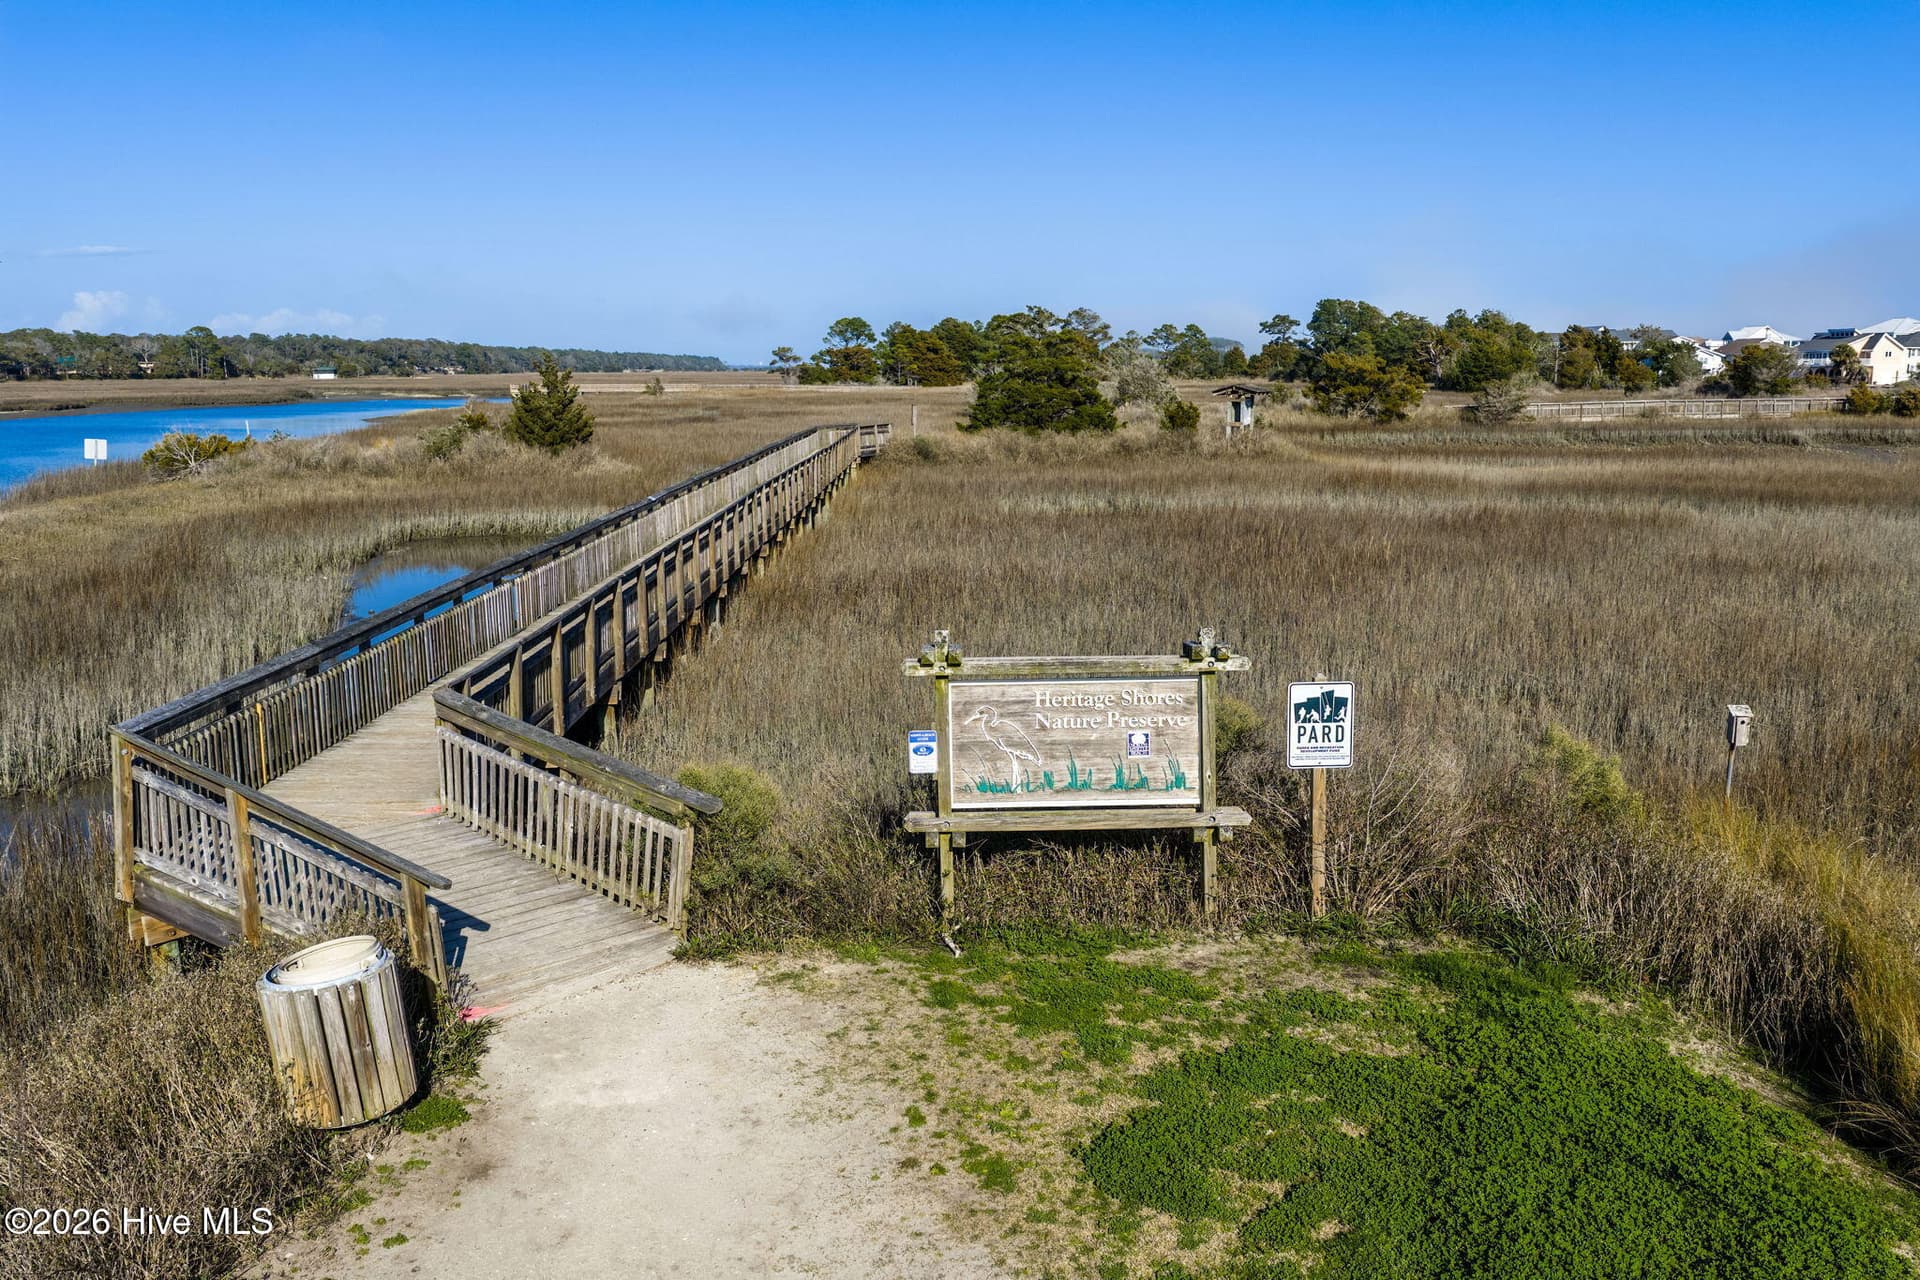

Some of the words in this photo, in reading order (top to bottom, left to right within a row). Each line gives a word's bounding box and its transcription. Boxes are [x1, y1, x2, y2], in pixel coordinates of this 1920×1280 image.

[1034, 690, 1115, 711] Heritage
[1120, 688, 1184, 706] Shores
[1034, 713, 1102, 730] Nature
[1106, 711, 1188, 729] Preserve
[1297, 725, 1345, 743] PARD
